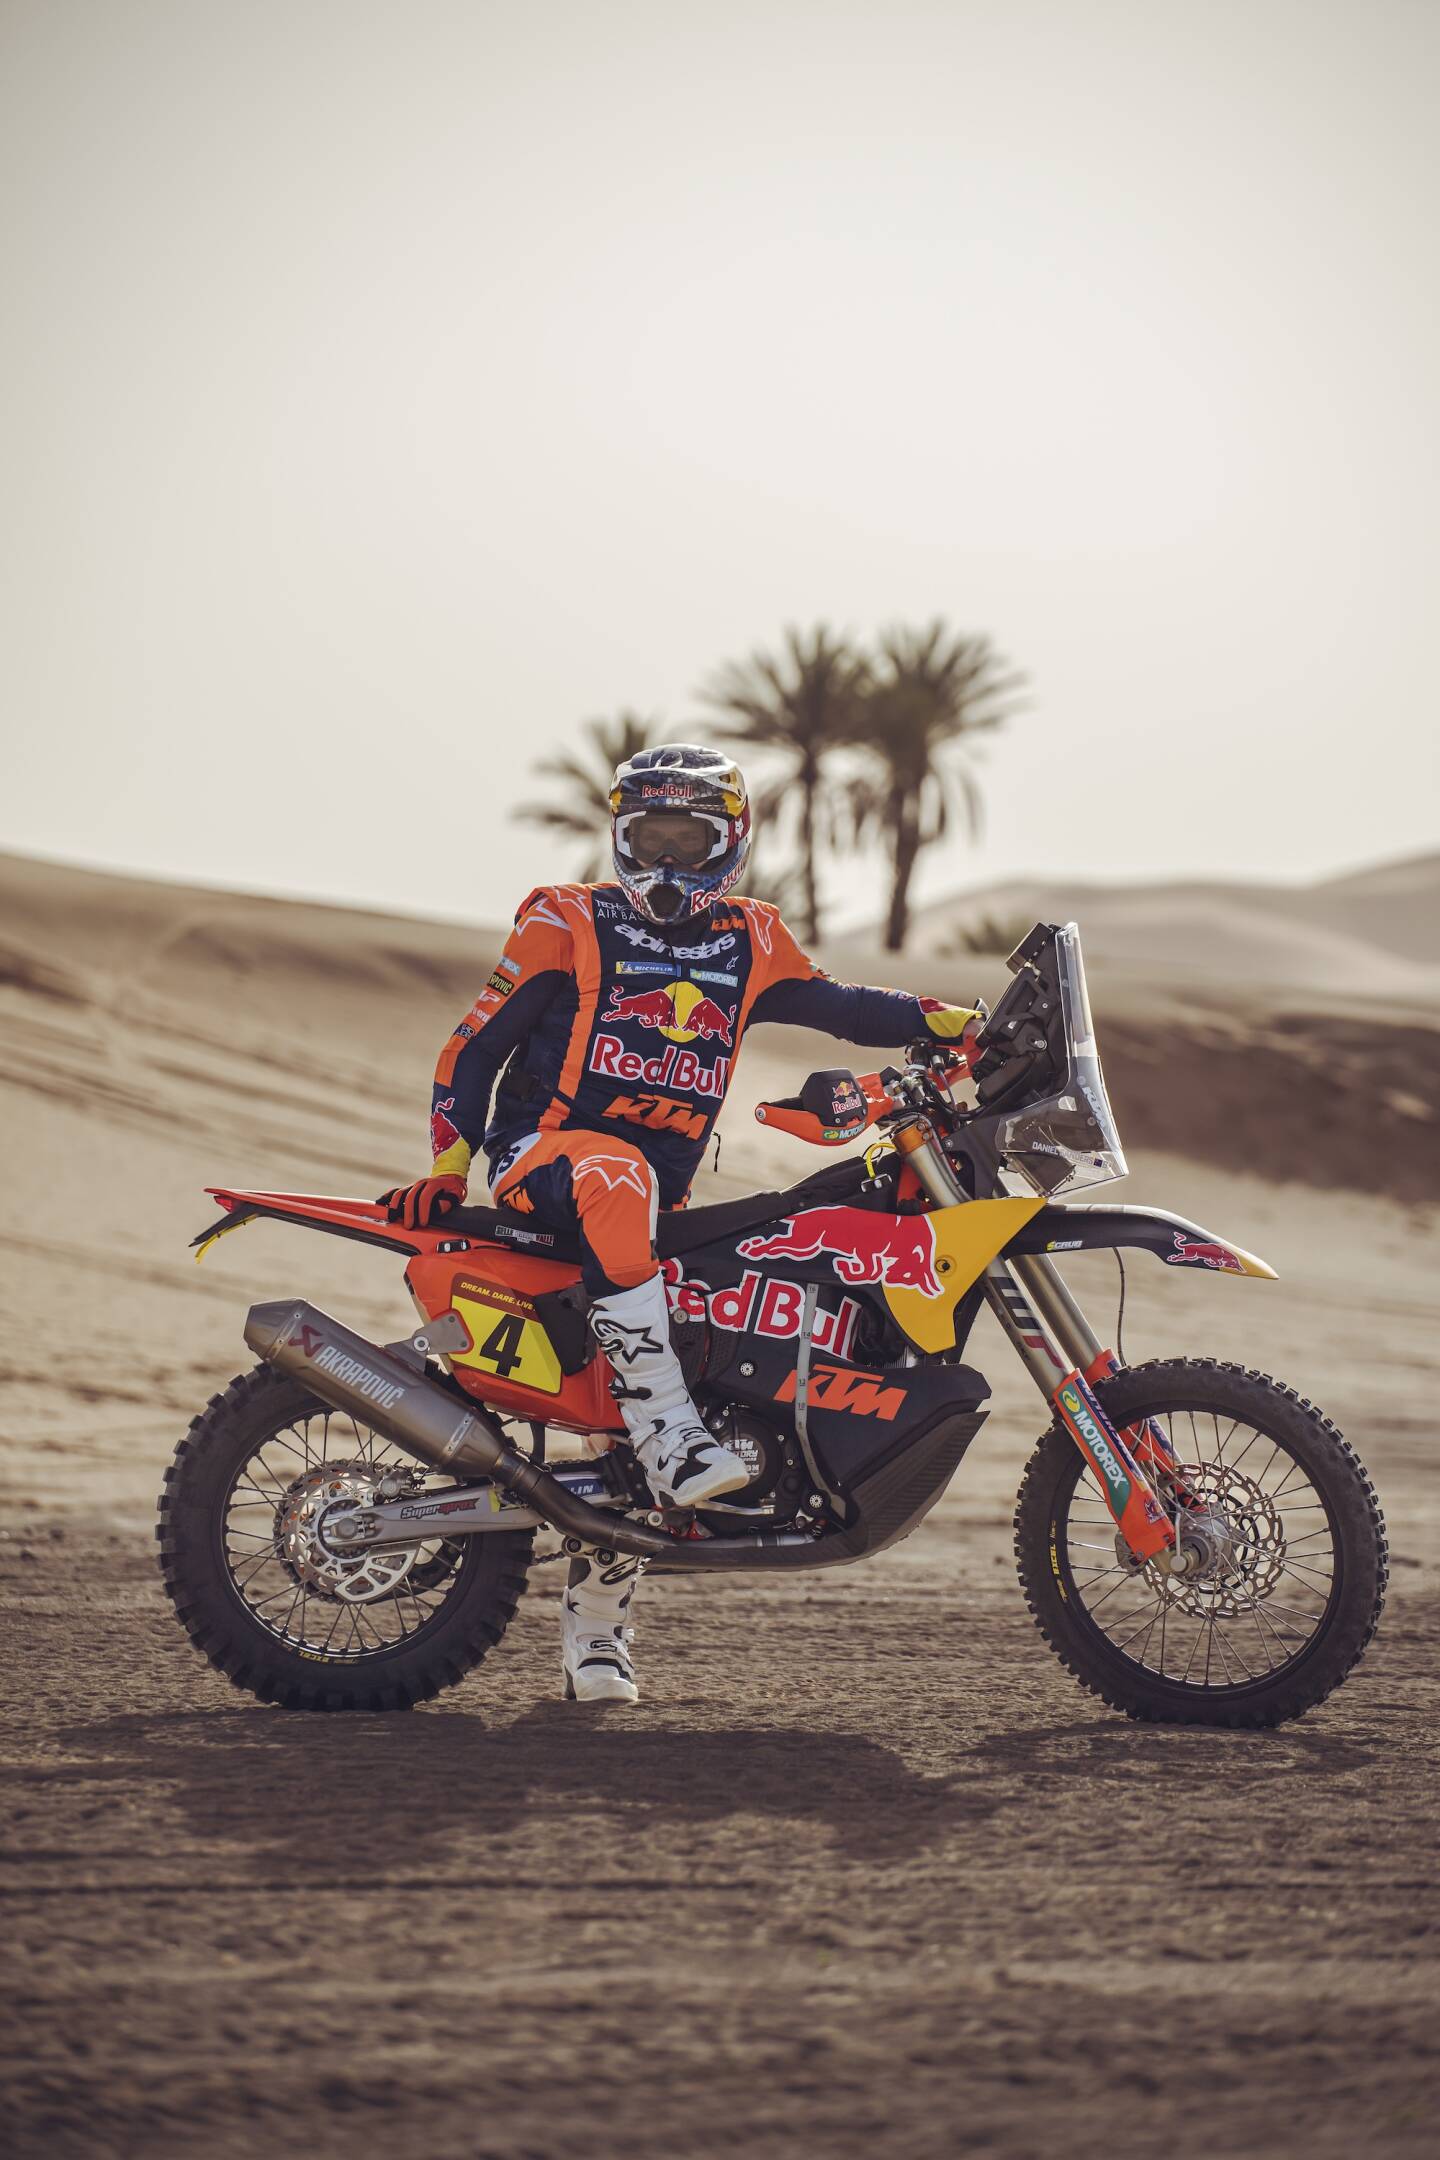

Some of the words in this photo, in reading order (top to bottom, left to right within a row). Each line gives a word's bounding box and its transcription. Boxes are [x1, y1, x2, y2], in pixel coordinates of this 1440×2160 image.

[642, 785, 666, 797] Red
[667, 785, 693, 798] Bull
[589, 1033, 677, 1086] Red
[601, 1093, 708, 1141] KTM
[1032, 1141, 1058, 1155] DANIEL
[461, 1282, 491, 1297] DREAM.
[492, 1292, 515, 1304] DARE.
[480, 1314, 526, 1376] 4
[773, 1364, 907, 1421] KTM
[1074, 1410, 1128, 1488] MOTOREX
